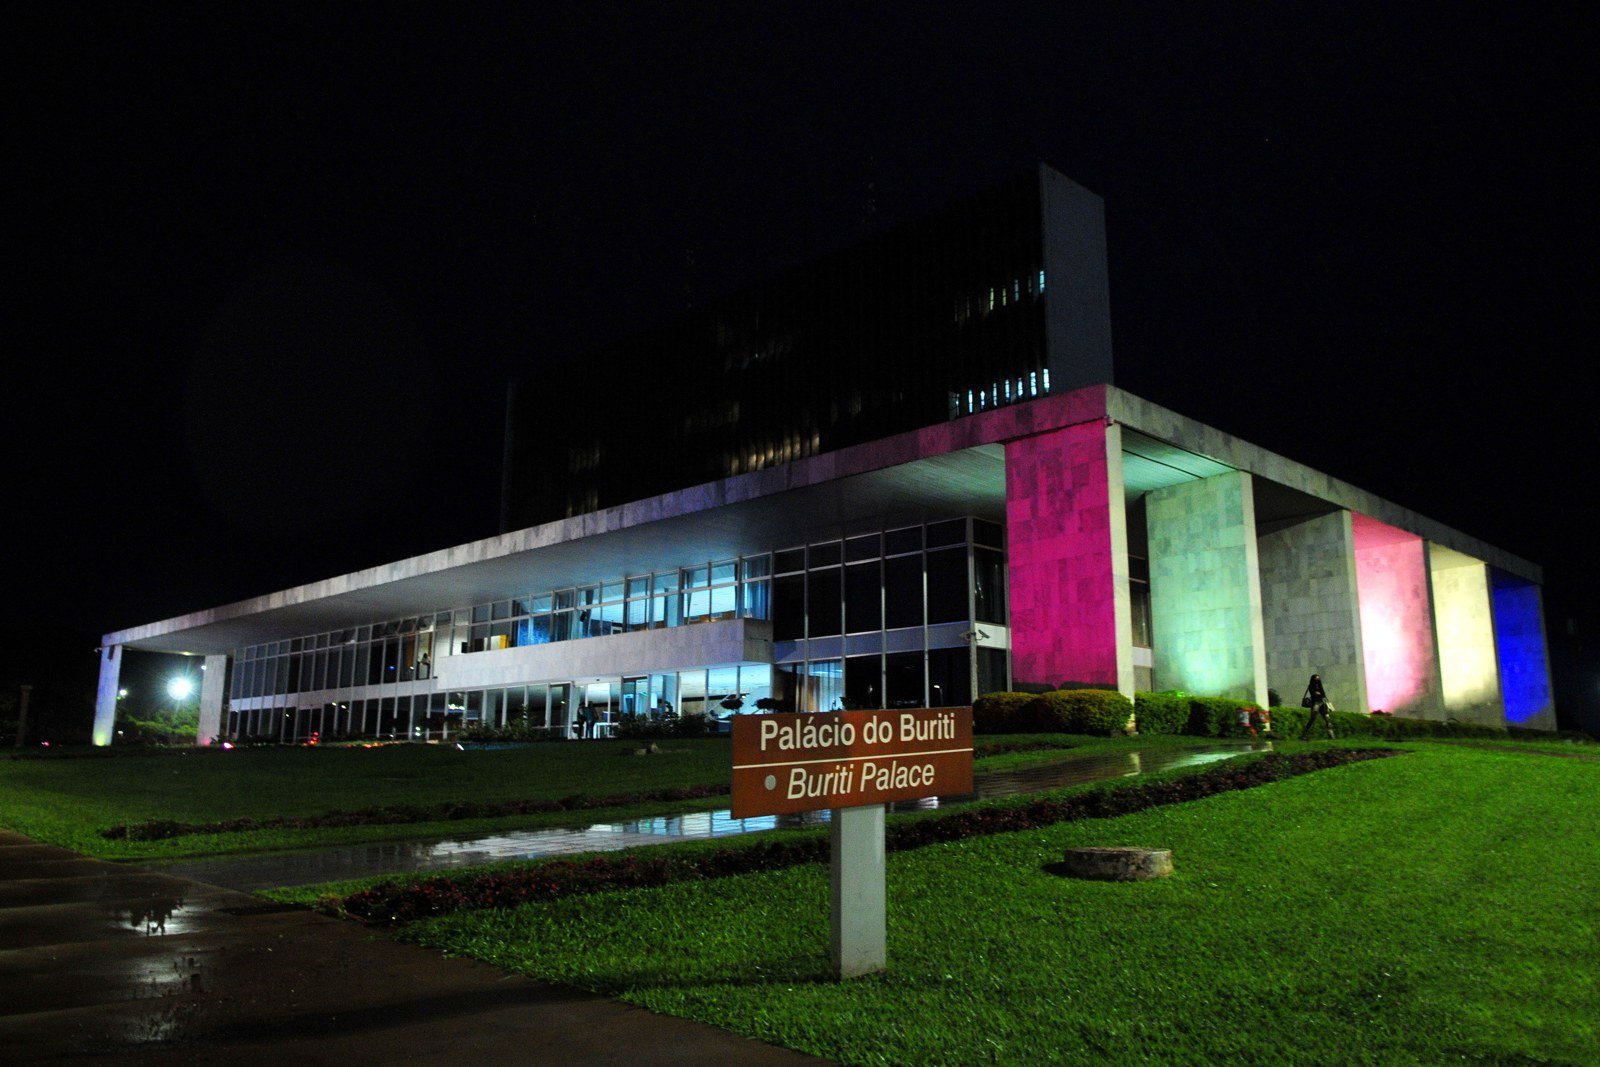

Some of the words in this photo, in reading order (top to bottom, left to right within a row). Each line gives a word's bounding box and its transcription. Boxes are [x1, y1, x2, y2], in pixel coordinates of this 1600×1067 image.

[760, 717, 856, 751] Palácio
[863, 715, 893, 745] do
[900, 713, 955, 742] Buriti
[787, 764, 854, 800] Buriti
[860, 761, 935, 792] Palace
